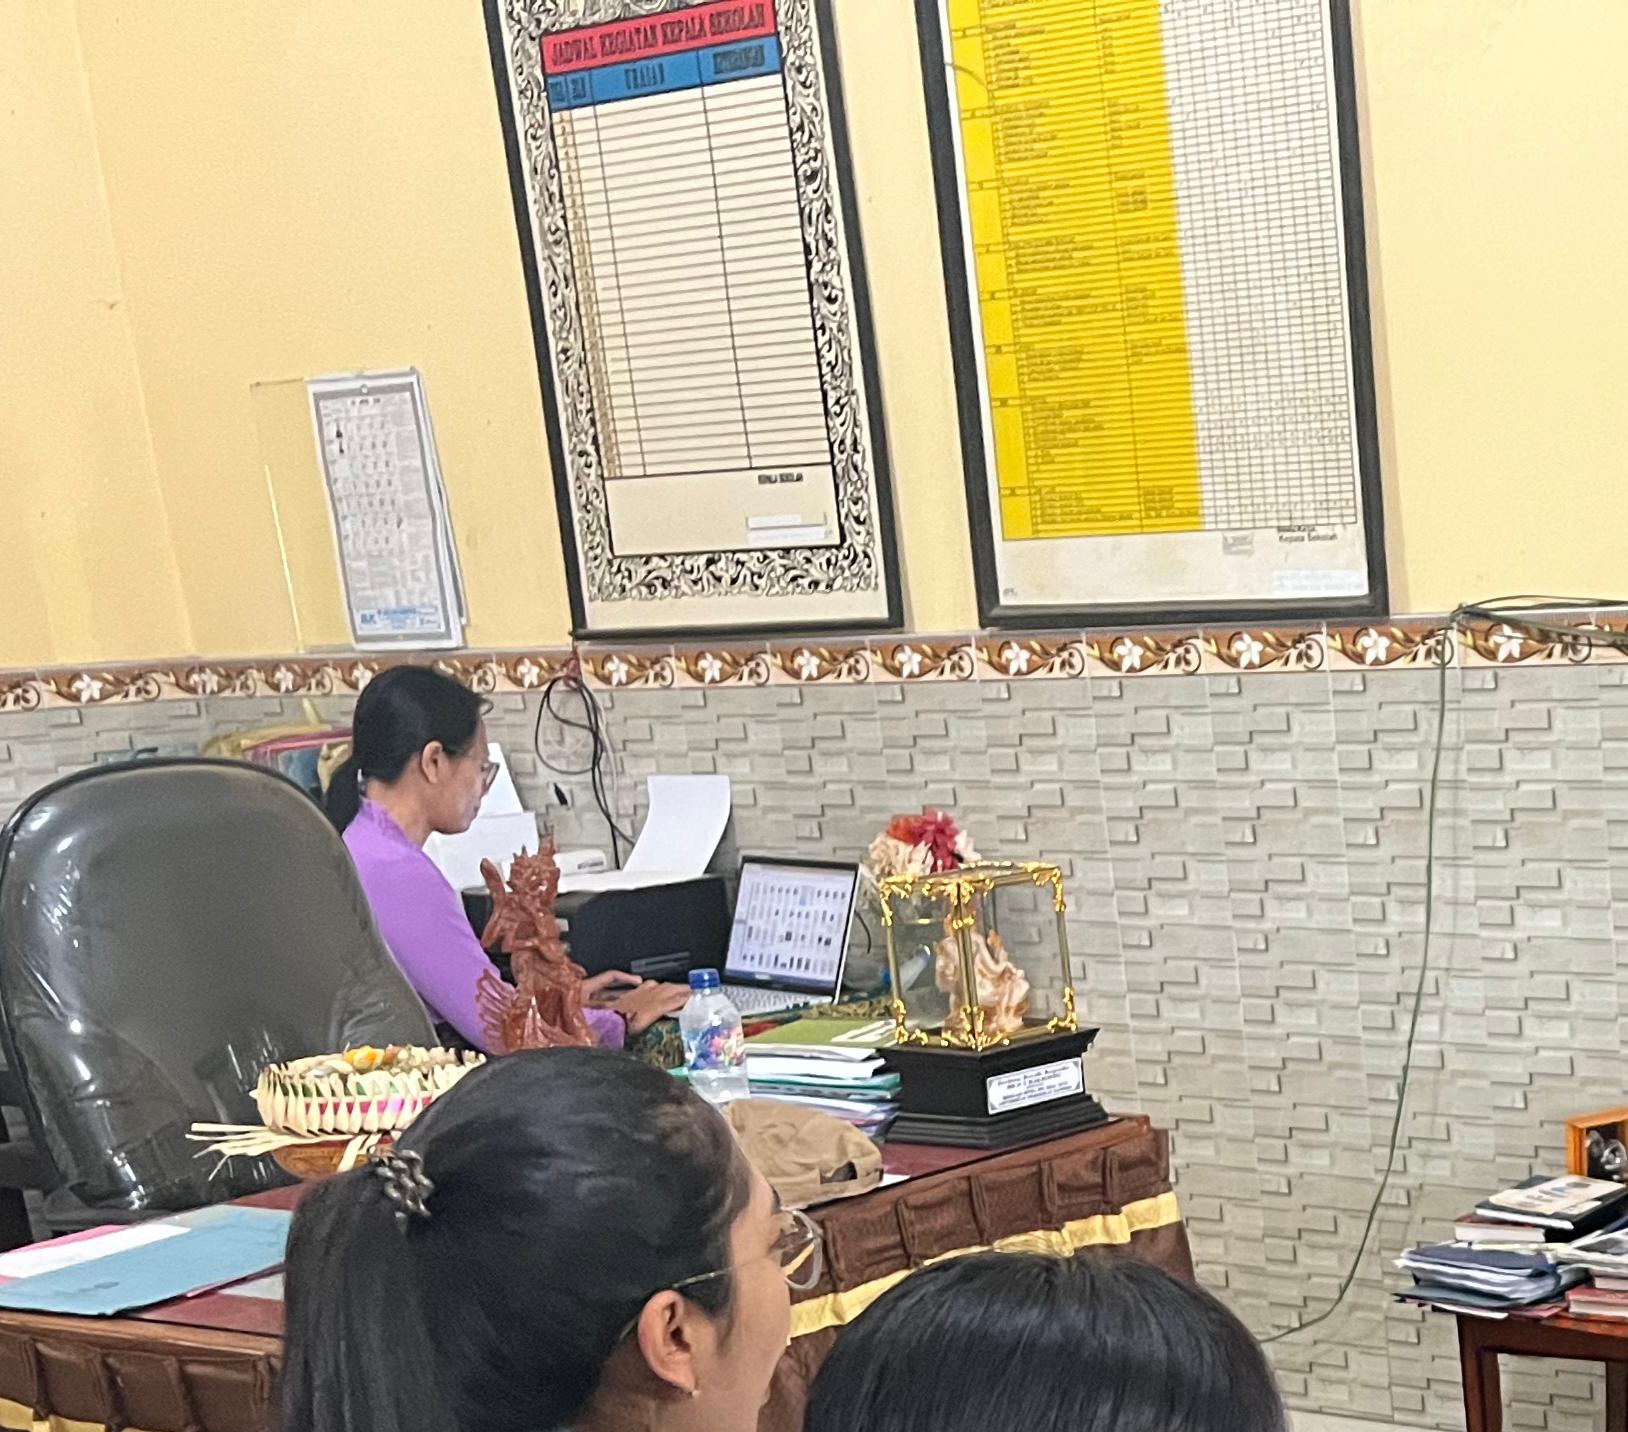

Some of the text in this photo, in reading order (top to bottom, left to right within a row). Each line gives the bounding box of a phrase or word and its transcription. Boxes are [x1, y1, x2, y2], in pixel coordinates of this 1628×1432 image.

[552, 3, 765, 66] JADWAL KEGIATAN KEPALA SEKOLAH
